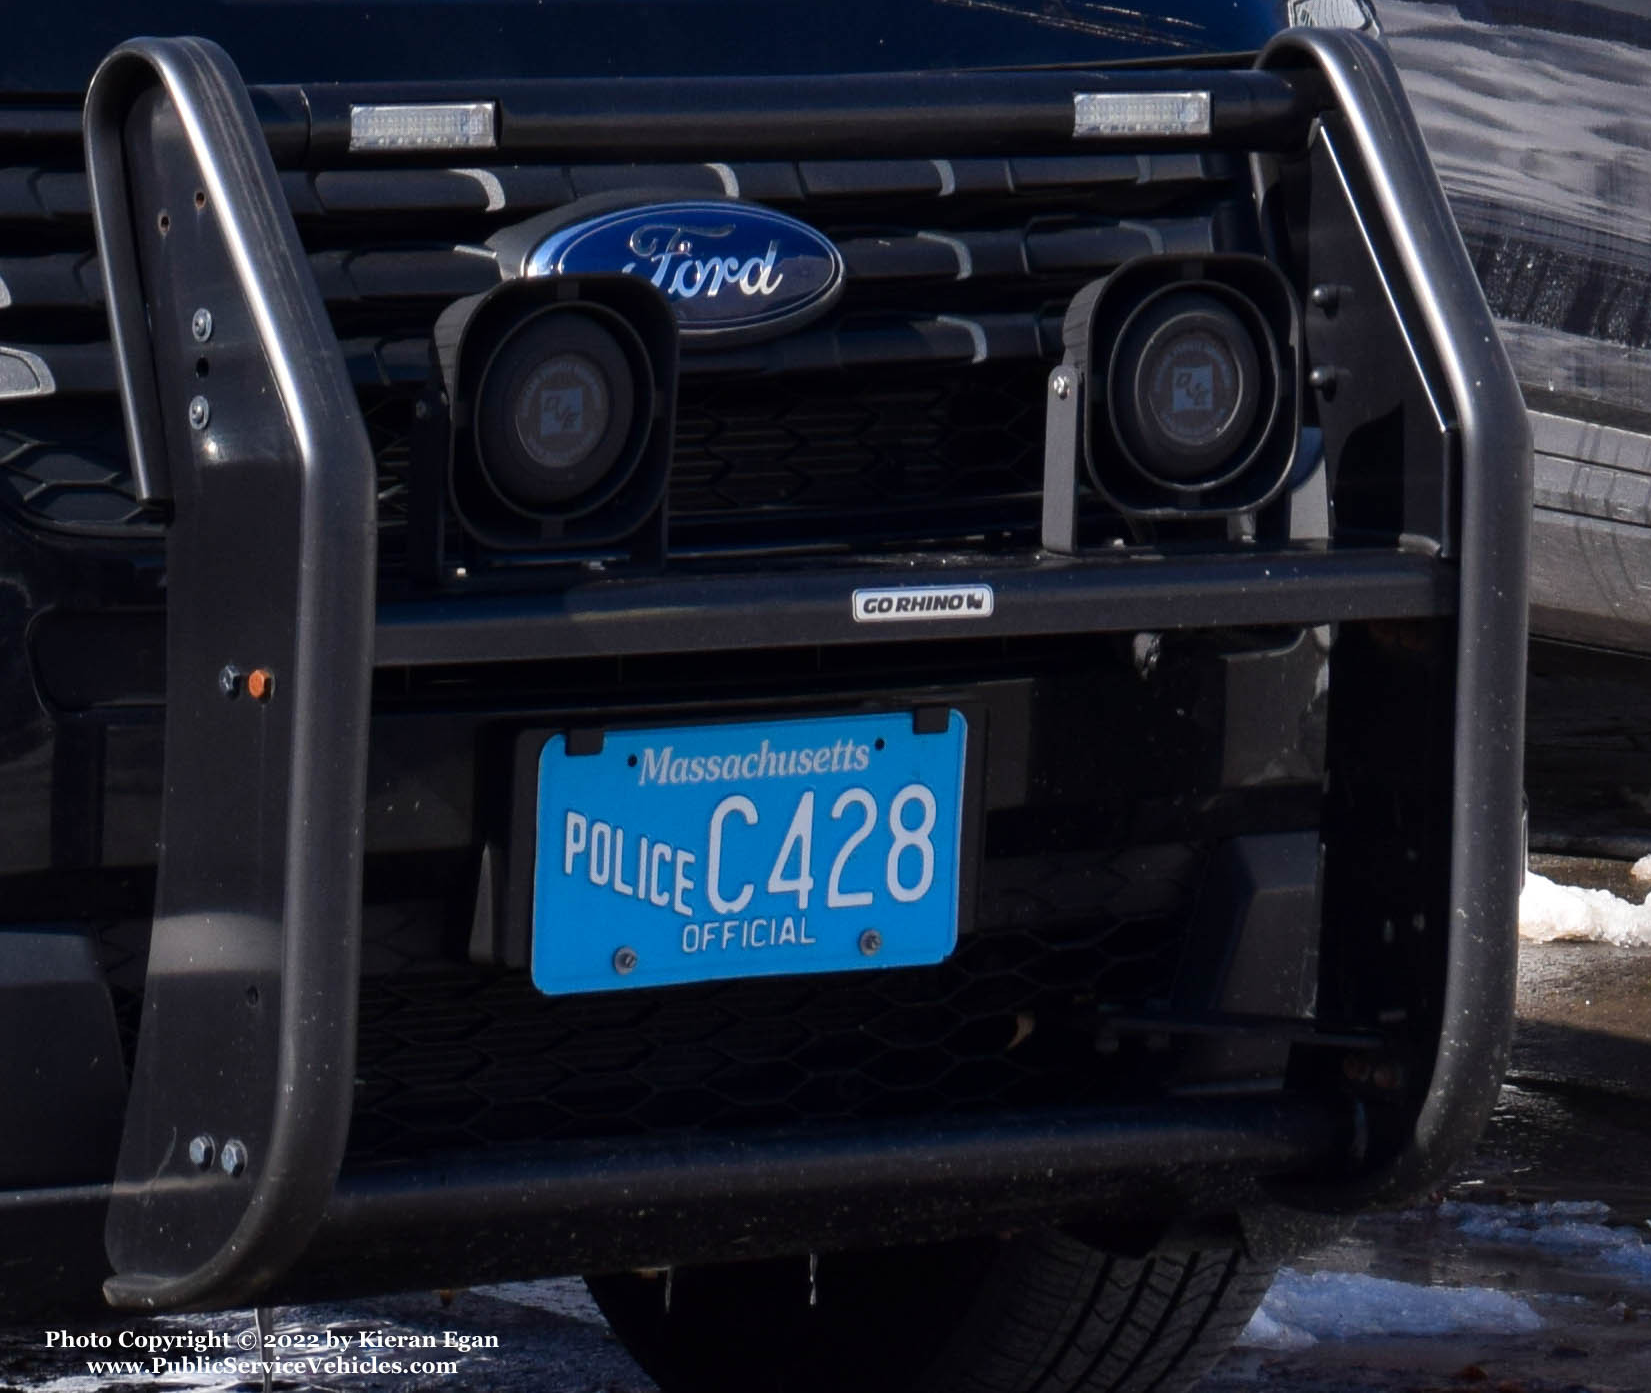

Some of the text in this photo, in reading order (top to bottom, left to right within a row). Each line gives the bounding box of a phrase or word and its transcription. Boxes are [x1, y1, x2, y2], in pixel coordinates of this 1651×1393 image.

[621, 222, 784, 297] Ford
[863, 594, 964, 615] GO RHINO
[637, 738, 871, 787] Massachusetts
[563, 783, 938, 917] POLICE C428
[681, 916, 817, 954] OFFICIAL
